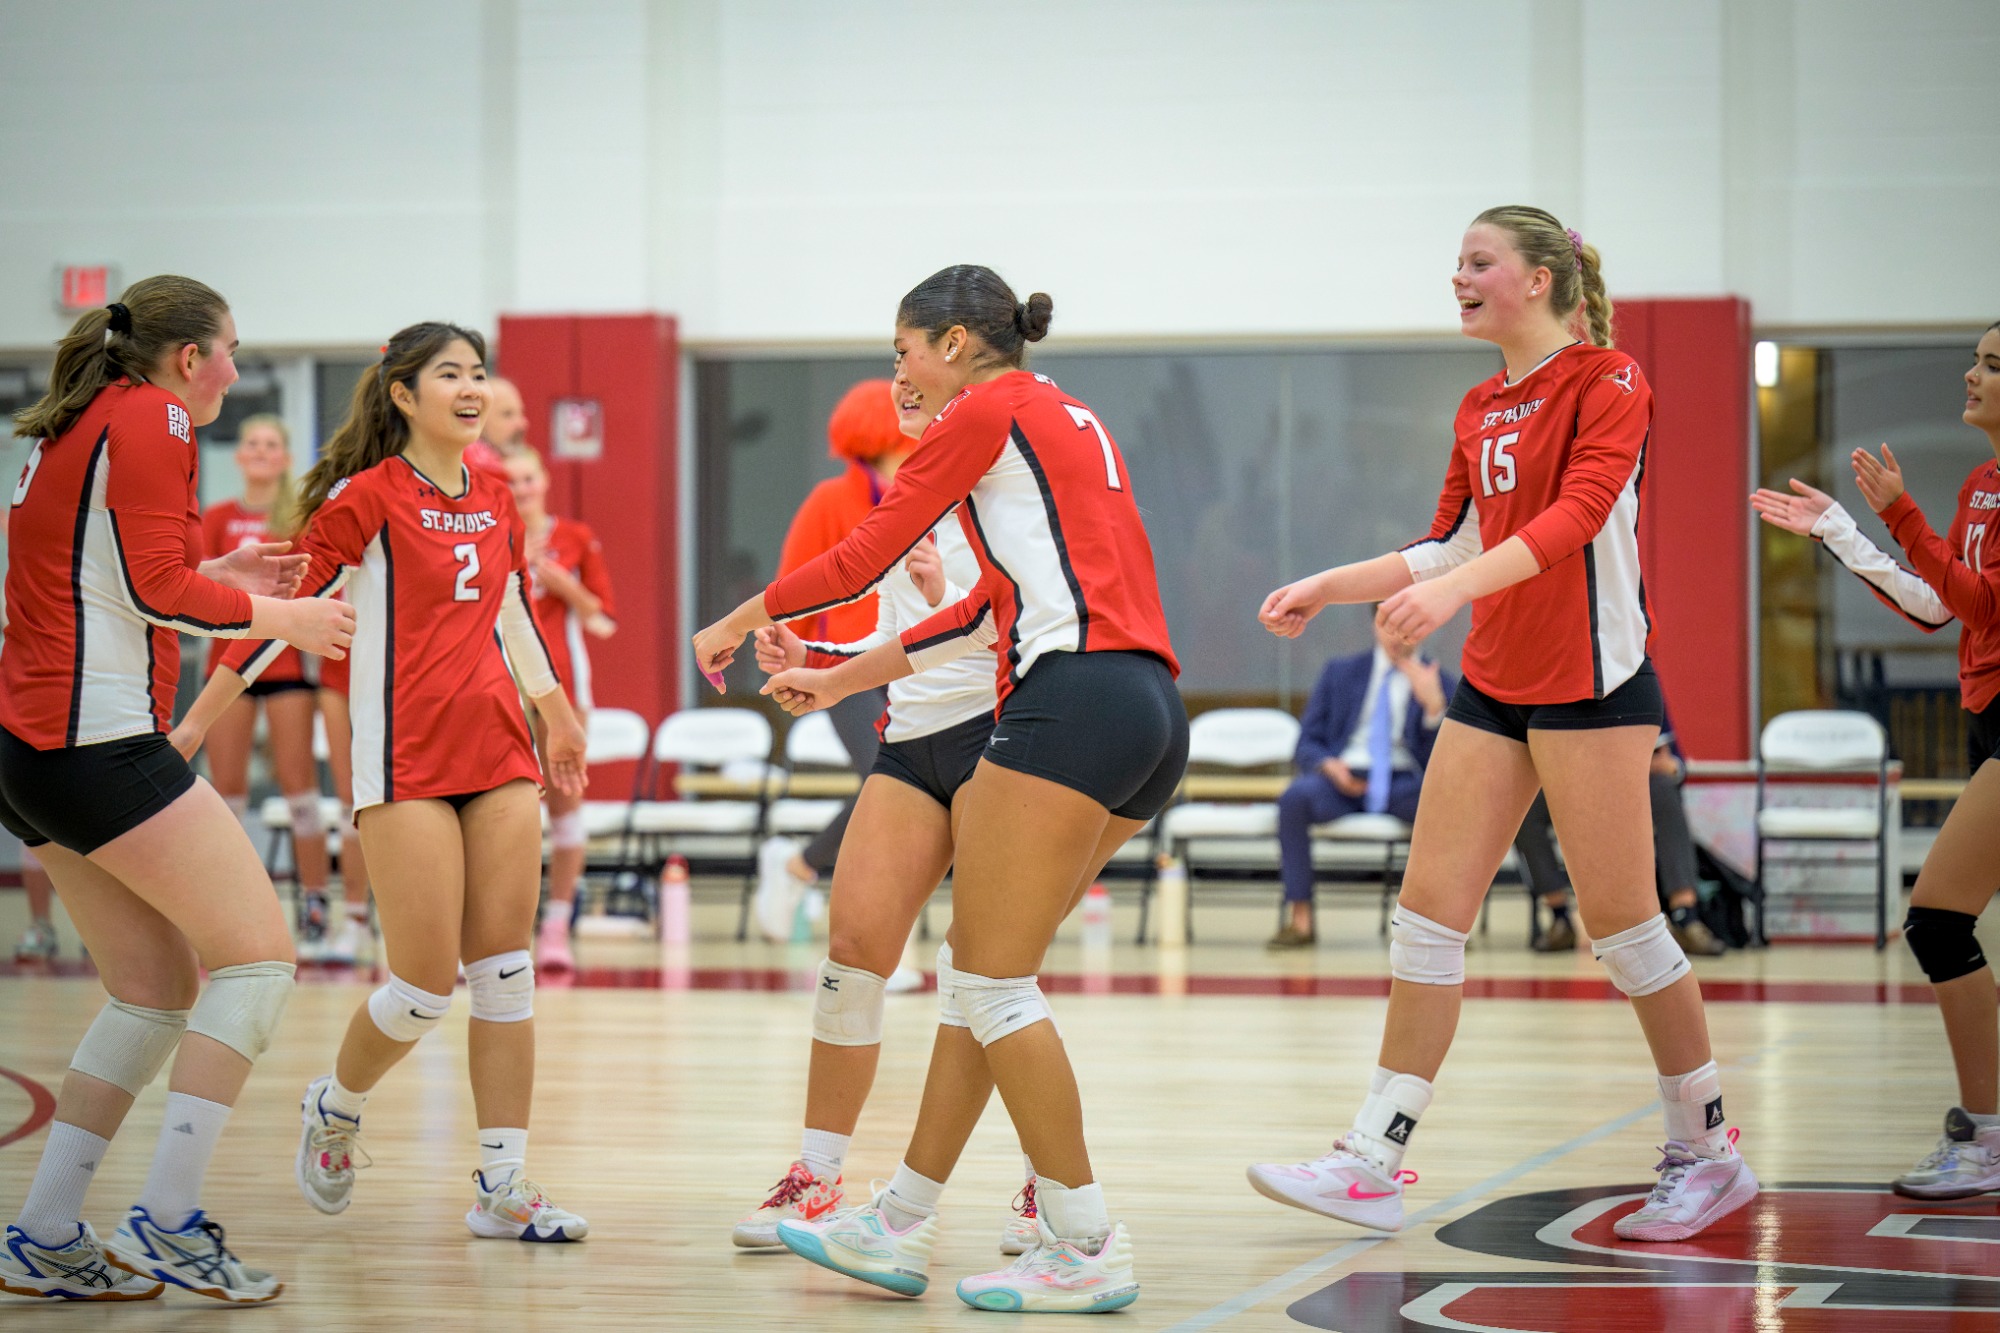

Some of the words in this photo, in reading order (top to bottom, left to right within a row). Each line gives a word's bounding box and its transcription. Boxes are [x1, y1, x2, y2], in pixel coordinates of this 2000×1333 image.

[165, 402, 190, 431] BIG
[1059, 401, 1123, 493] 7
[1480, 430, 1521, 499] 15
[453, 543, 481, 602] 2
[1963, 522, 1986, 575] 17
